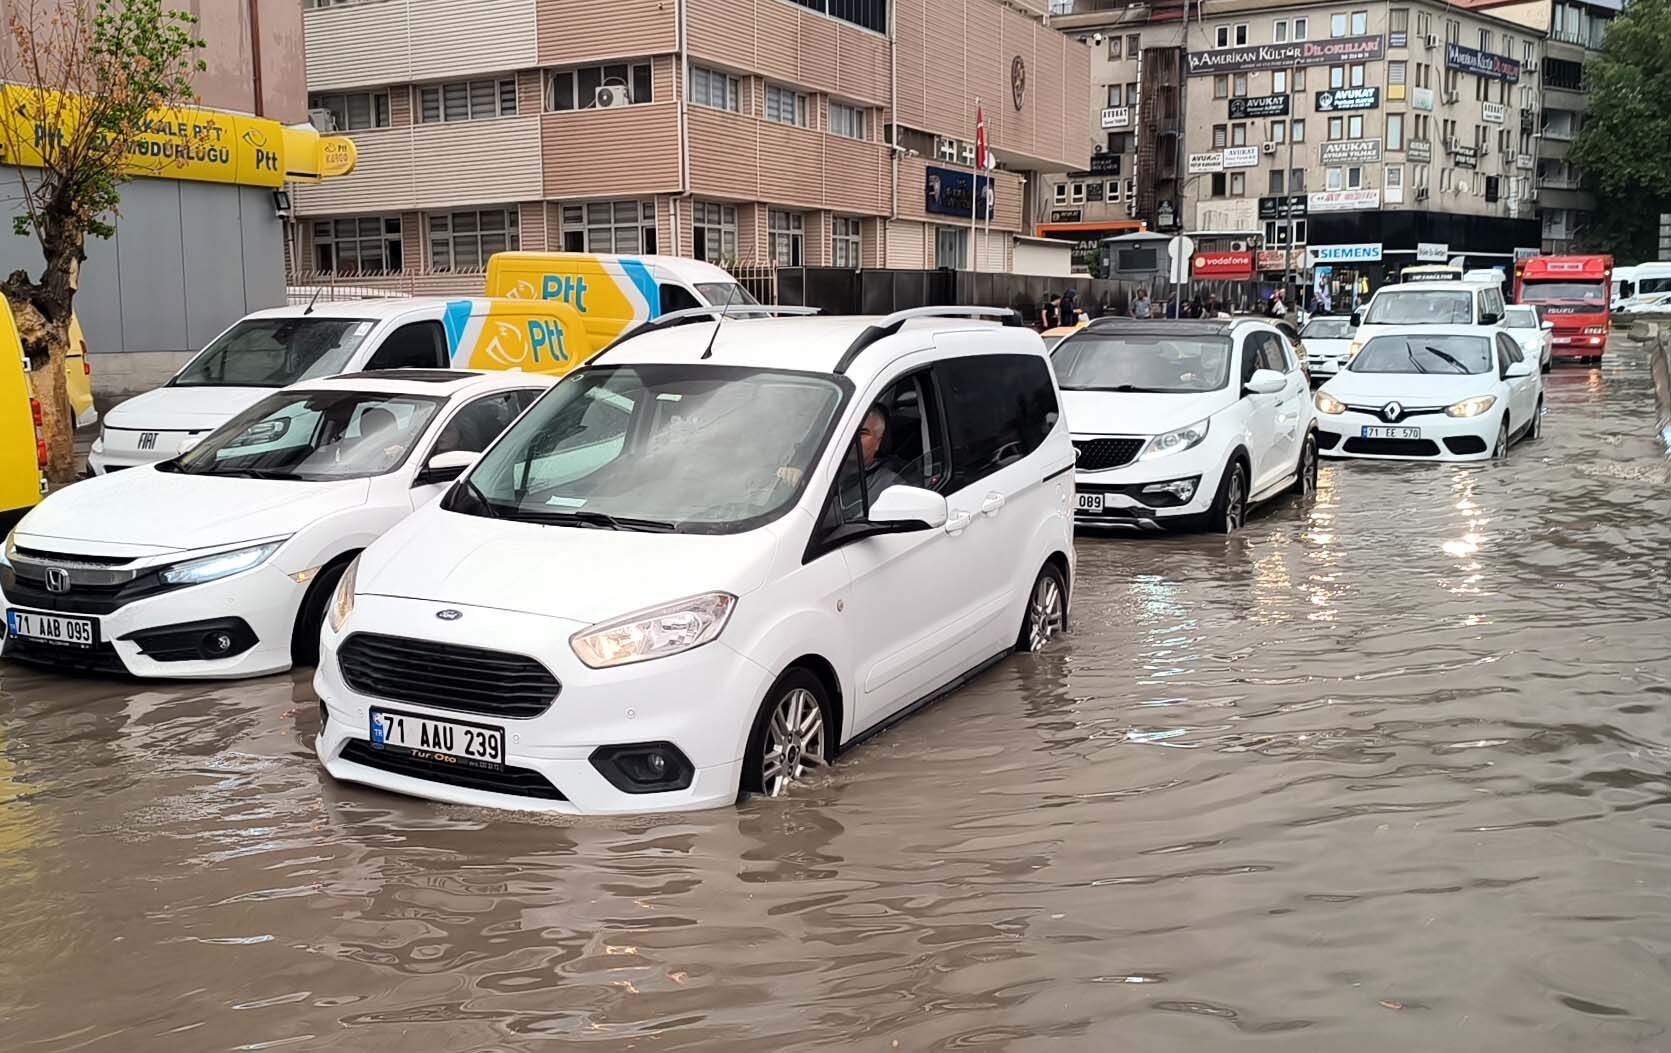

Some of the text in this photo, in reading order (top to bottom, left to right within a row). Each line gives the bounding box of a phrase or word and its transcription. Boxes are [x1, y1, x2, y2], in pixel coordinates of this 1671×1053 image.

[1335, 88, 1375, 99] AVUKAT
[1246, 97, 1284, 107] AVUKAT
[1326, 142, 1374, 152] AVUKAT
[256, 149, 278, 172] Ptt
[1321, 247, 1380, 259] SIEMENS
[1206, 257, 1249, 265] vodafone
[542, 275, 588, 313] Ptt
[527, 319, 569, 363] Ptt
[1368, 428, 1378, 437] 71
[1402, 428, 1418, 438] 570
[138, 432, 159, 450] FIAT
[1079, 495, 1101, 508] 089
[16, 614, 31, 635] 71
[39, 617, 61, 638] AAB
[66, 621, 90, 642] 095
[384, 715, 499, 760] 71 AAU 239
[434, 752, 457, 765] Oto
